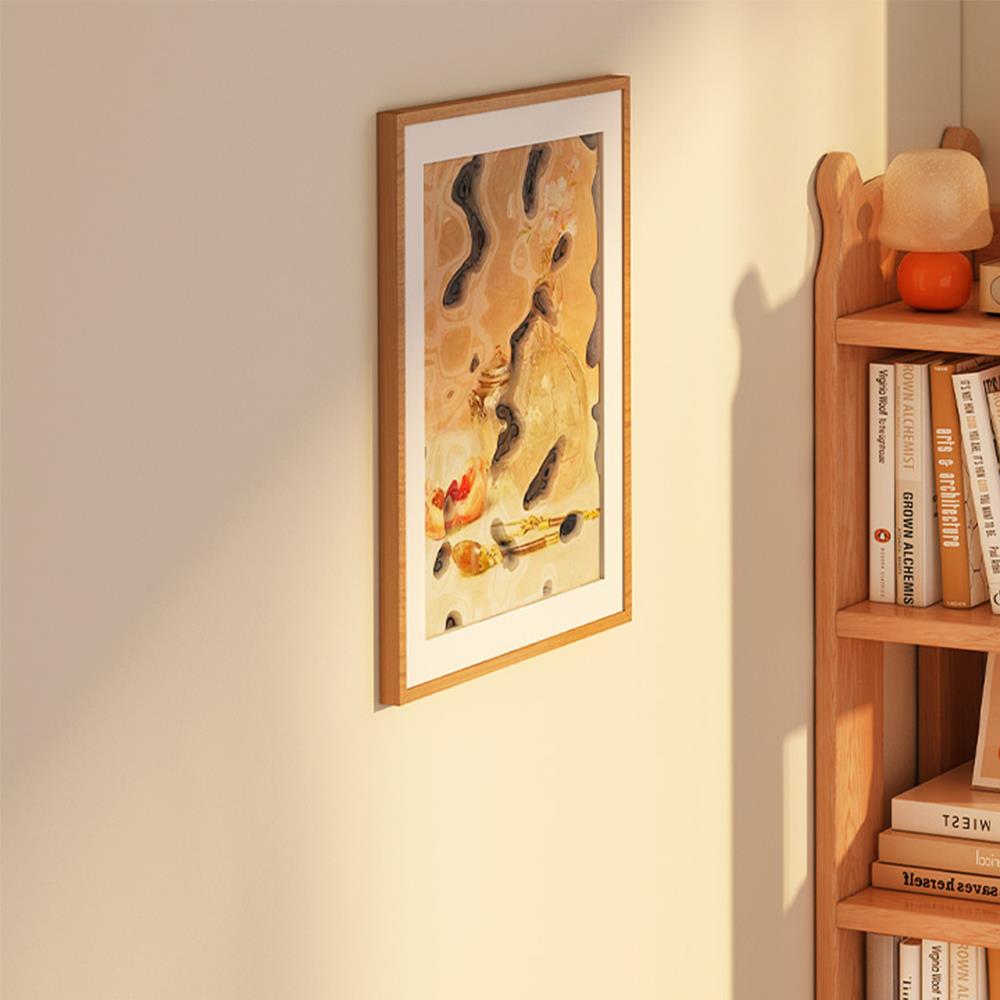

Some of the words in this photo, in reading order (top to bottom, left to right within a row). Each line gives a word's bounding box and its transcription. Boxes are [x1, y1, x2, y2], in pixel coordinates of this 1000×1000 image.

[876, 369, 888, 395] Virginia
[879, 396, 888, 416] Woolf
[903, 404, 914, 472] ALCHEMIST
[936, 428, 955, 452] arts
[903, 492, 913, 539] GROWN
[939, 473, 960, 547] architecture
[903, 542, 914, 606] ALCHEMIS
[929, 945, 942, 973] Virginia
[932, 973, 942, 995] Woolf
